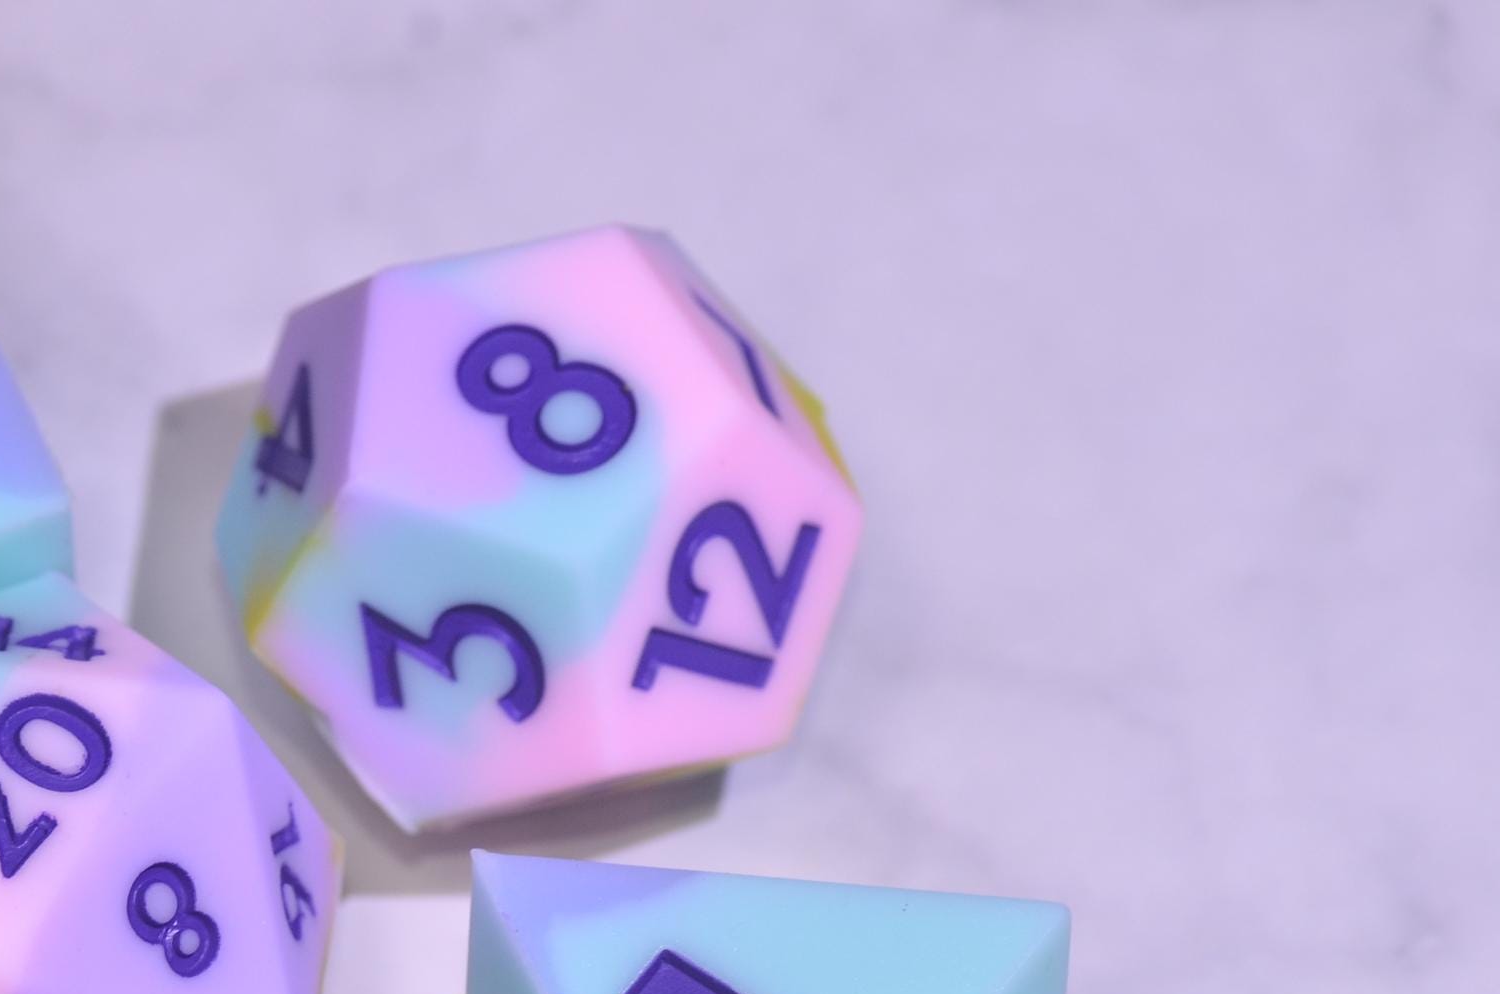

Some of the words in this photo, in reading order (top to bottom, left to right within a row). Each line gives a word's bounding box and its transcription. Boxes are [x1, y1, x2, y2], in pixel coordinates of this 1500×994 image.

[254, 361, 315, 497] 4
[455, 324, 638, 474] 8
[359, 601, 546, 723] 3
[632, 500, 822, 692] 12
[126, 860, 221, 978] 8
